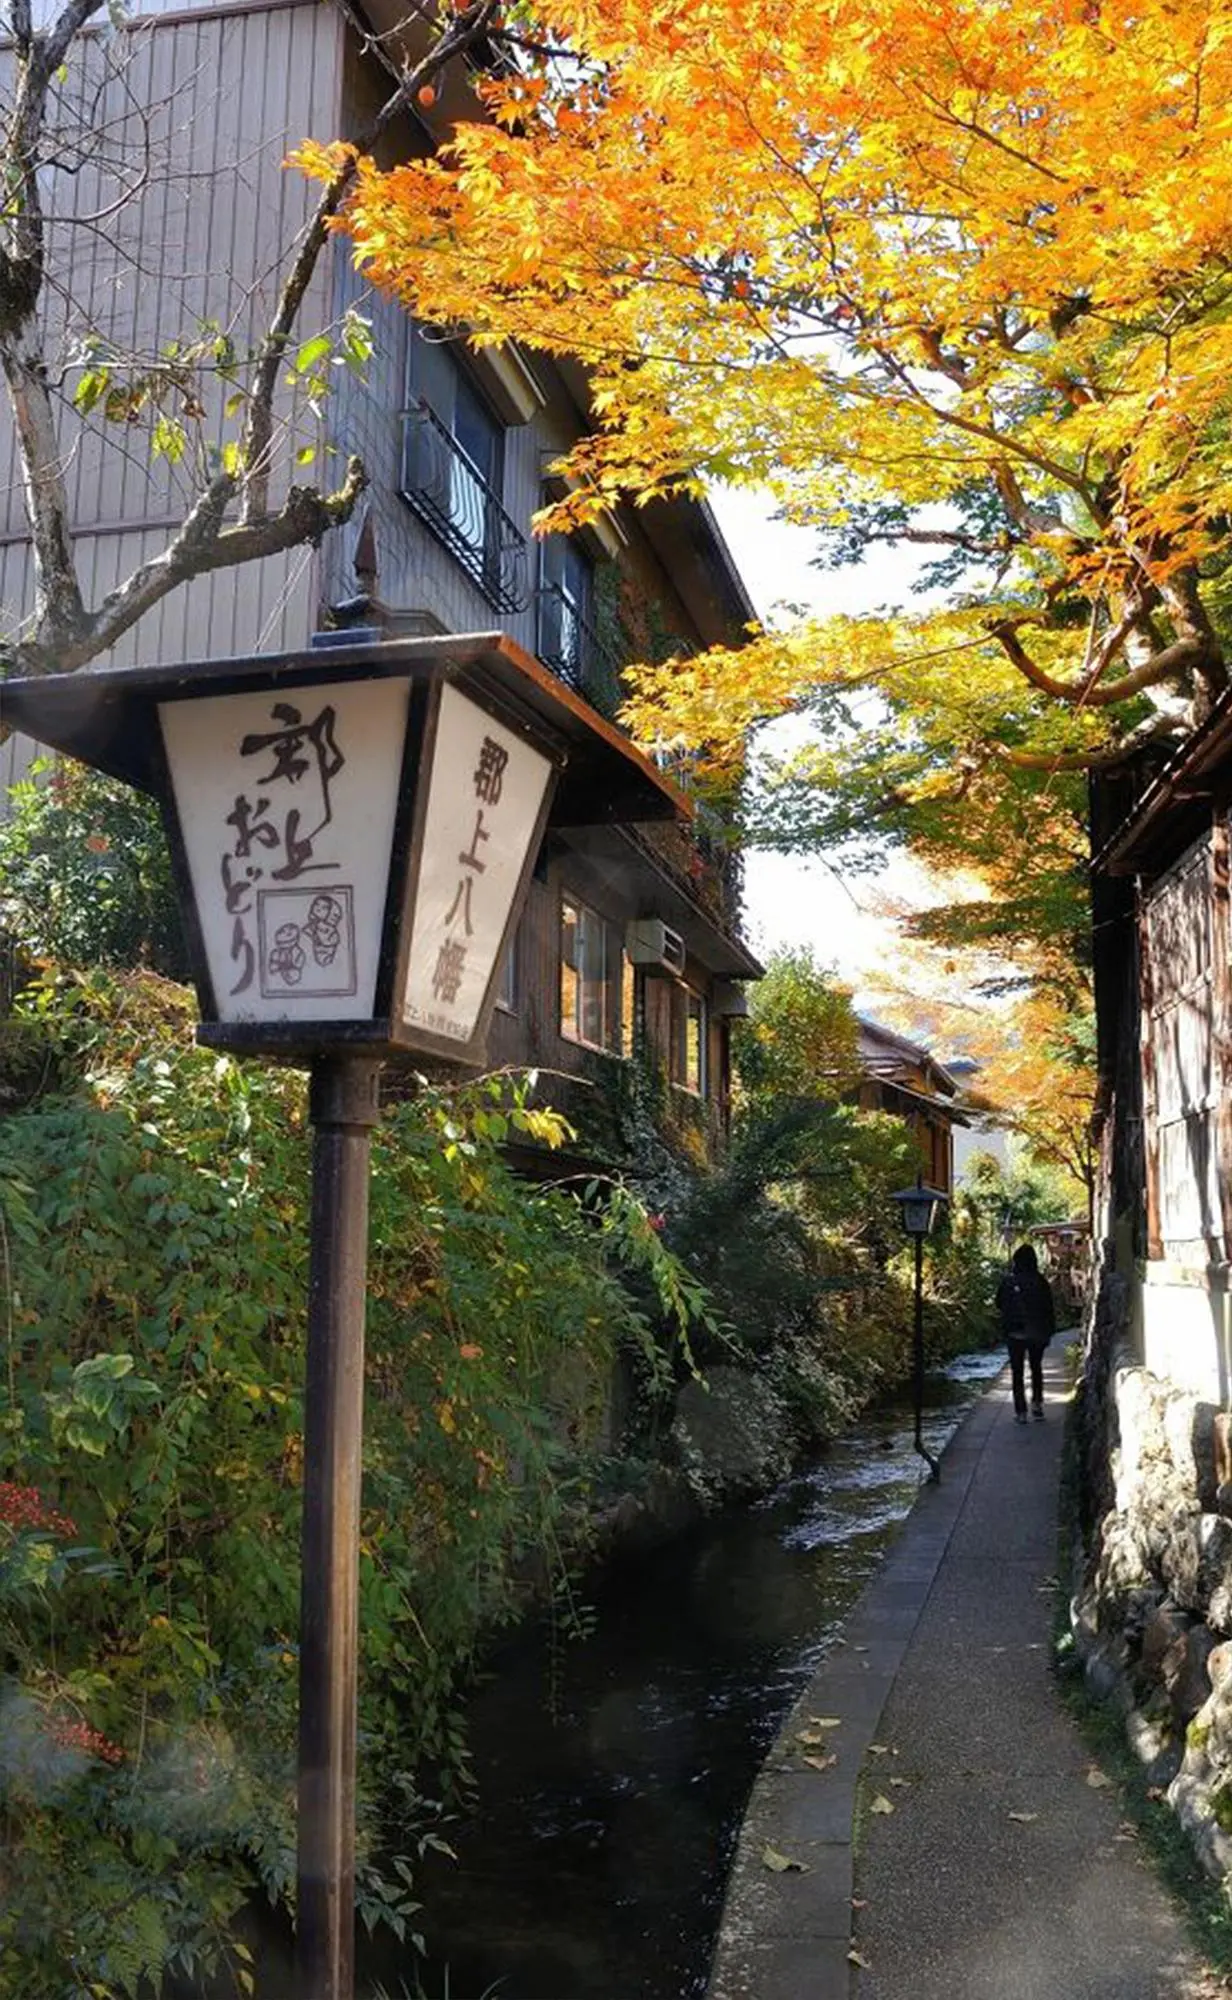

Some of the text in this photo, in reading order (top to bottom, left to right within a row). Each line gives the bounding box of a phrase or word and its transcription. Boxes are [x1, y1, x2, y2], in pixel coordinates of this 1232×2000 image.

[241, 703, 345, 880] 郡上
[431, 736, 509, 1005] 郡上八幡
[221, 794, 279, 996] おどり
